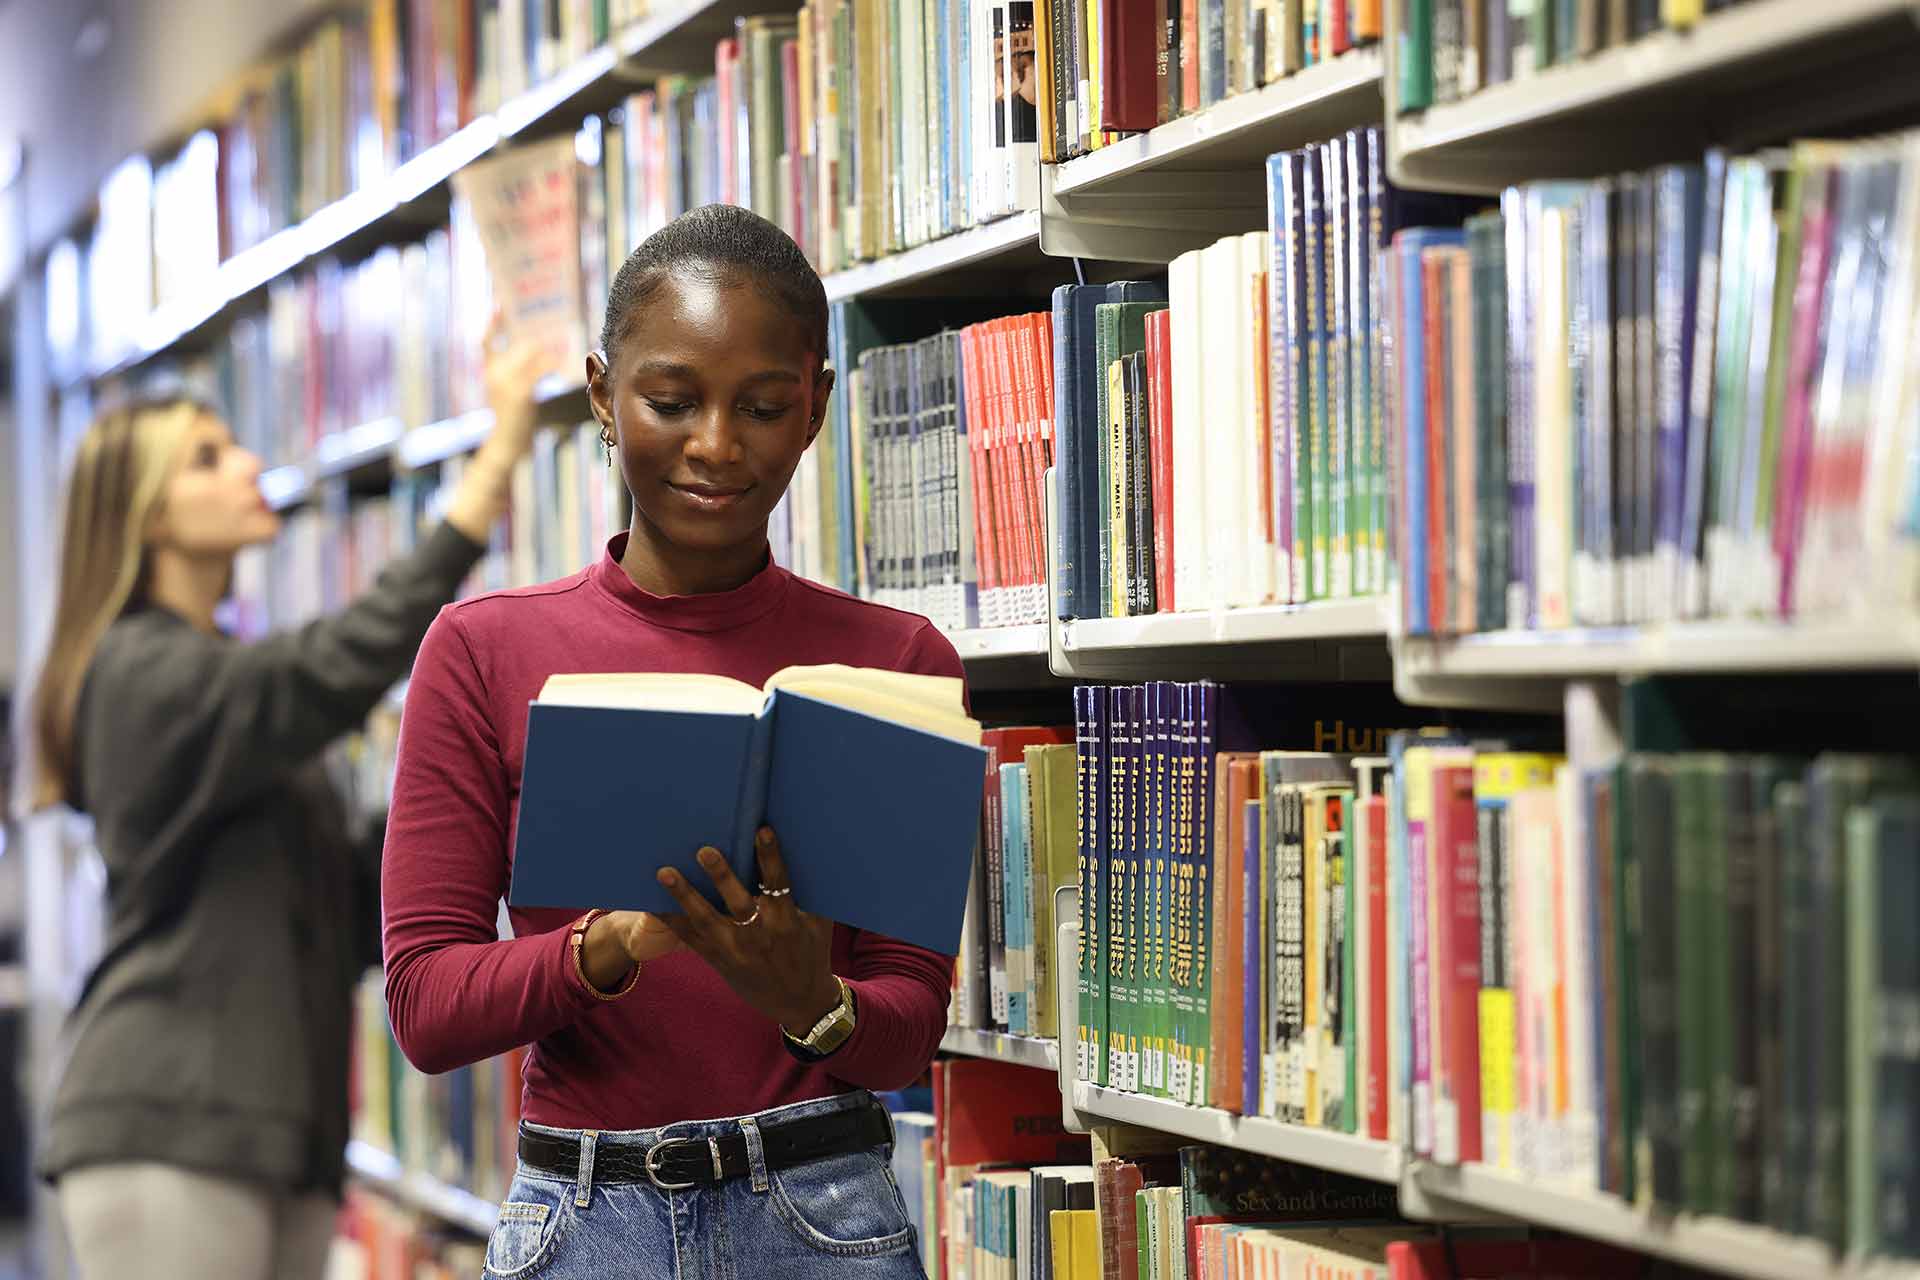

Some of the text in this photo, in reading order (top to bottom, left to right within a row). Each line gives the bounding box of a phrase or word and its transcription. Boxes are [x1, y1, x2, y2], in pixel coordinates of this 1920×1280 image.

[1078, 756, 1086, 973] Human Sexuality
[1090, 756, 1098, 976] Human Sexuality
[1111, 757, 1119, 849] Human
[1117, 757, 1126, 979] Human Sexuality
[1129, 757, 1139, 982] Human Sexuality
[1177, 757, 1189, 987] Human Sexuality
[1155, 858, 1164, 980] Sexuality
[1169, 861, 1178, 981] Sexuality
[1197, 864, 1207, 990] Sexuality
[1236, 1191, 1271, 1213] Sex
[1277, 1190, 1316, 1212] and
